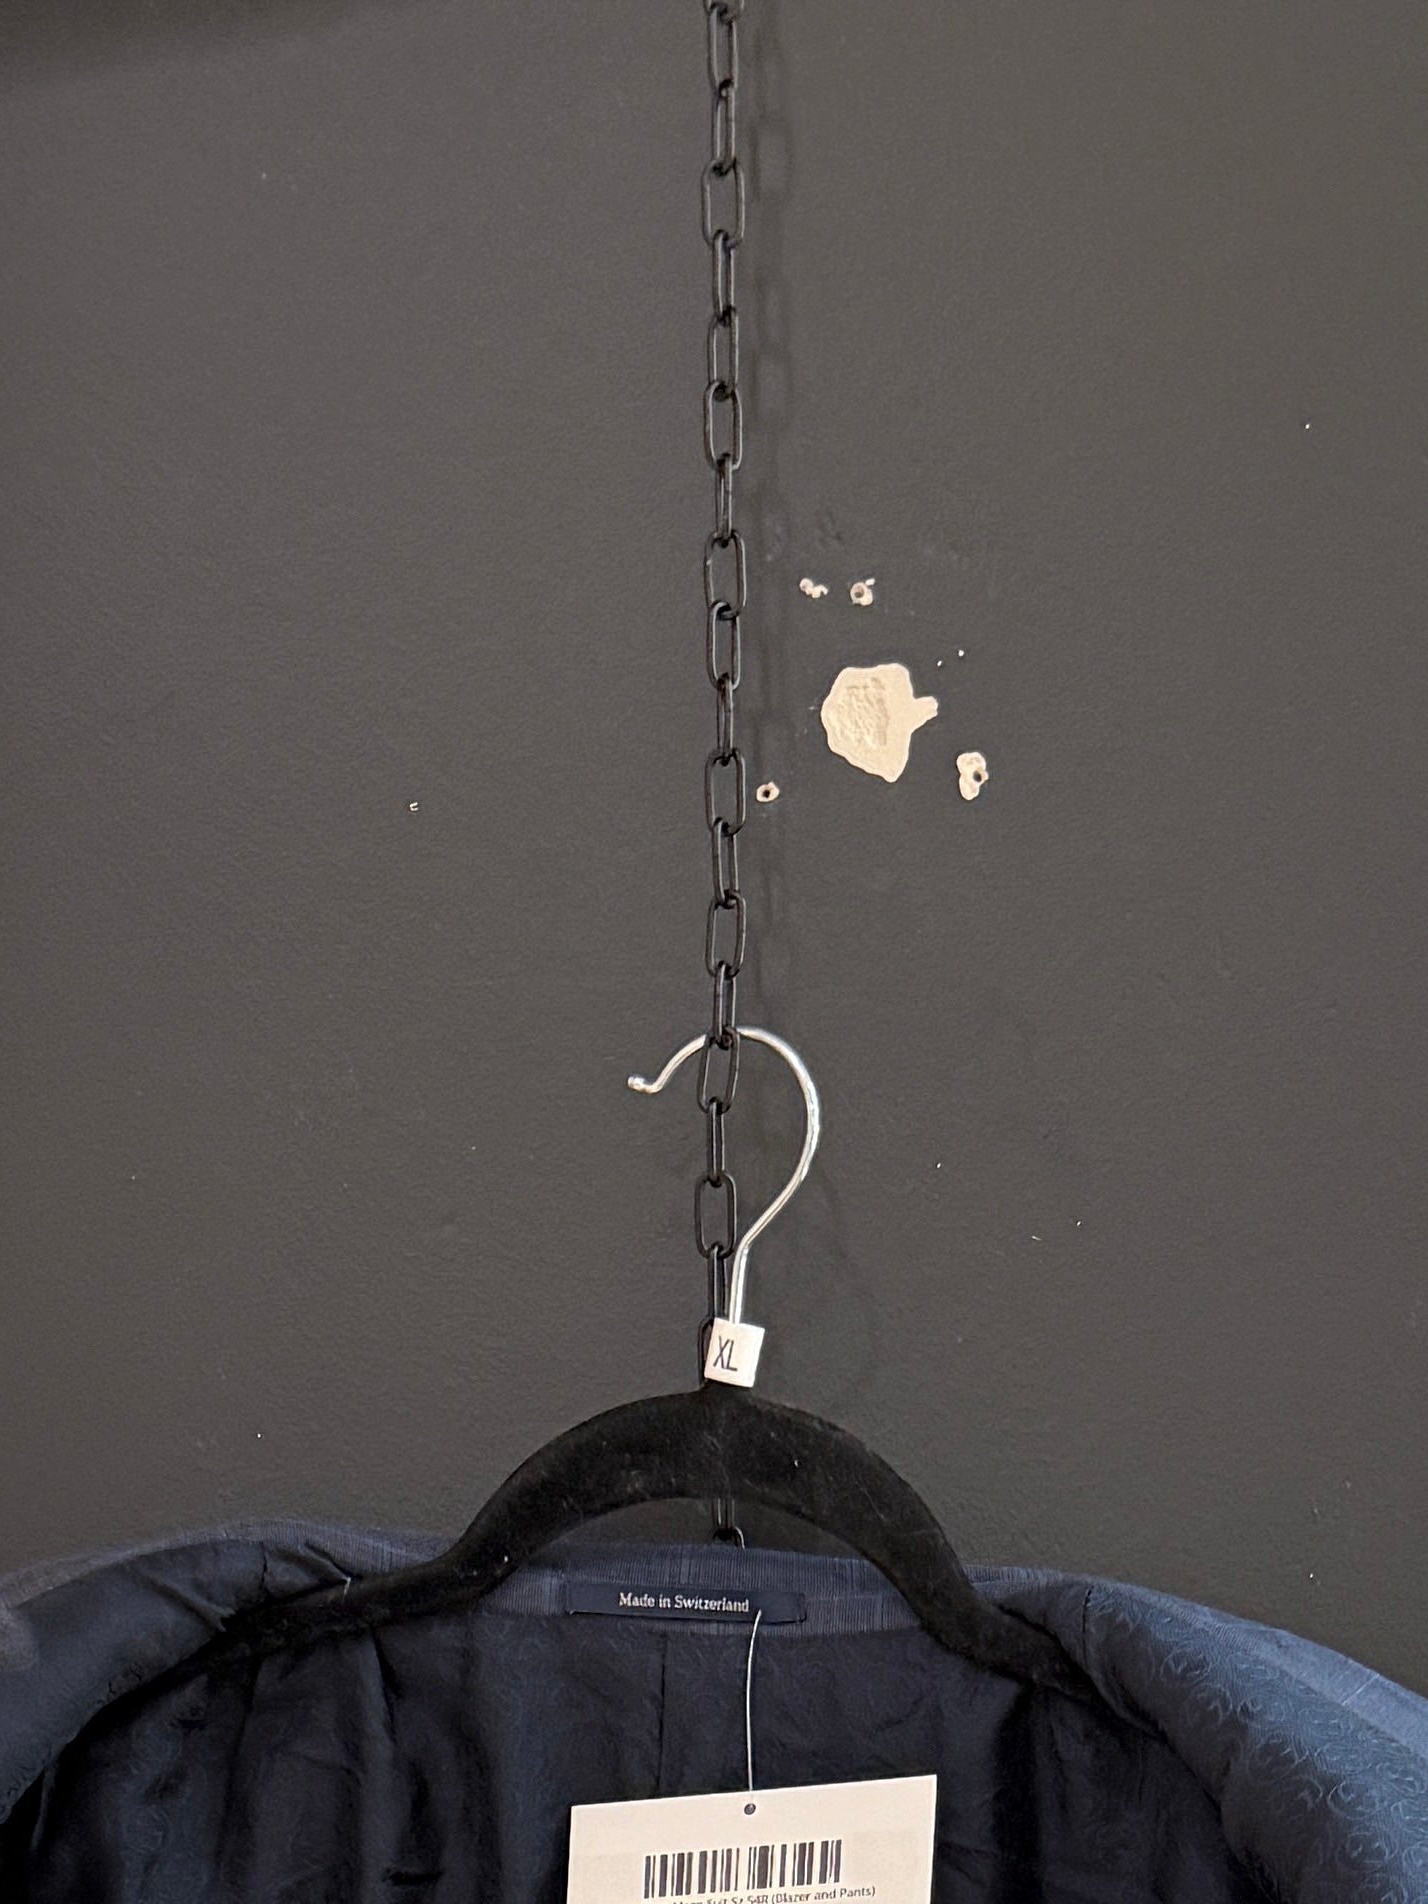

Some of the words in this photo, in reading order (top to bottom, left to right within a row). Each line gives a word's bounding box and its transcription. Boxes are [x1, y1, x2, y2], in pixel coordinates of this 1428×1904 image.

[713, 1335, 738, 1372] XL
[619, 1592, 655, 1607] Made
[659, 1593, 671, 1608] in
[674, 1595, 749, 1612] Switzerland
[814, 1888, 836, 1900] and
[840, 1886, 876, 1898] Pants)
